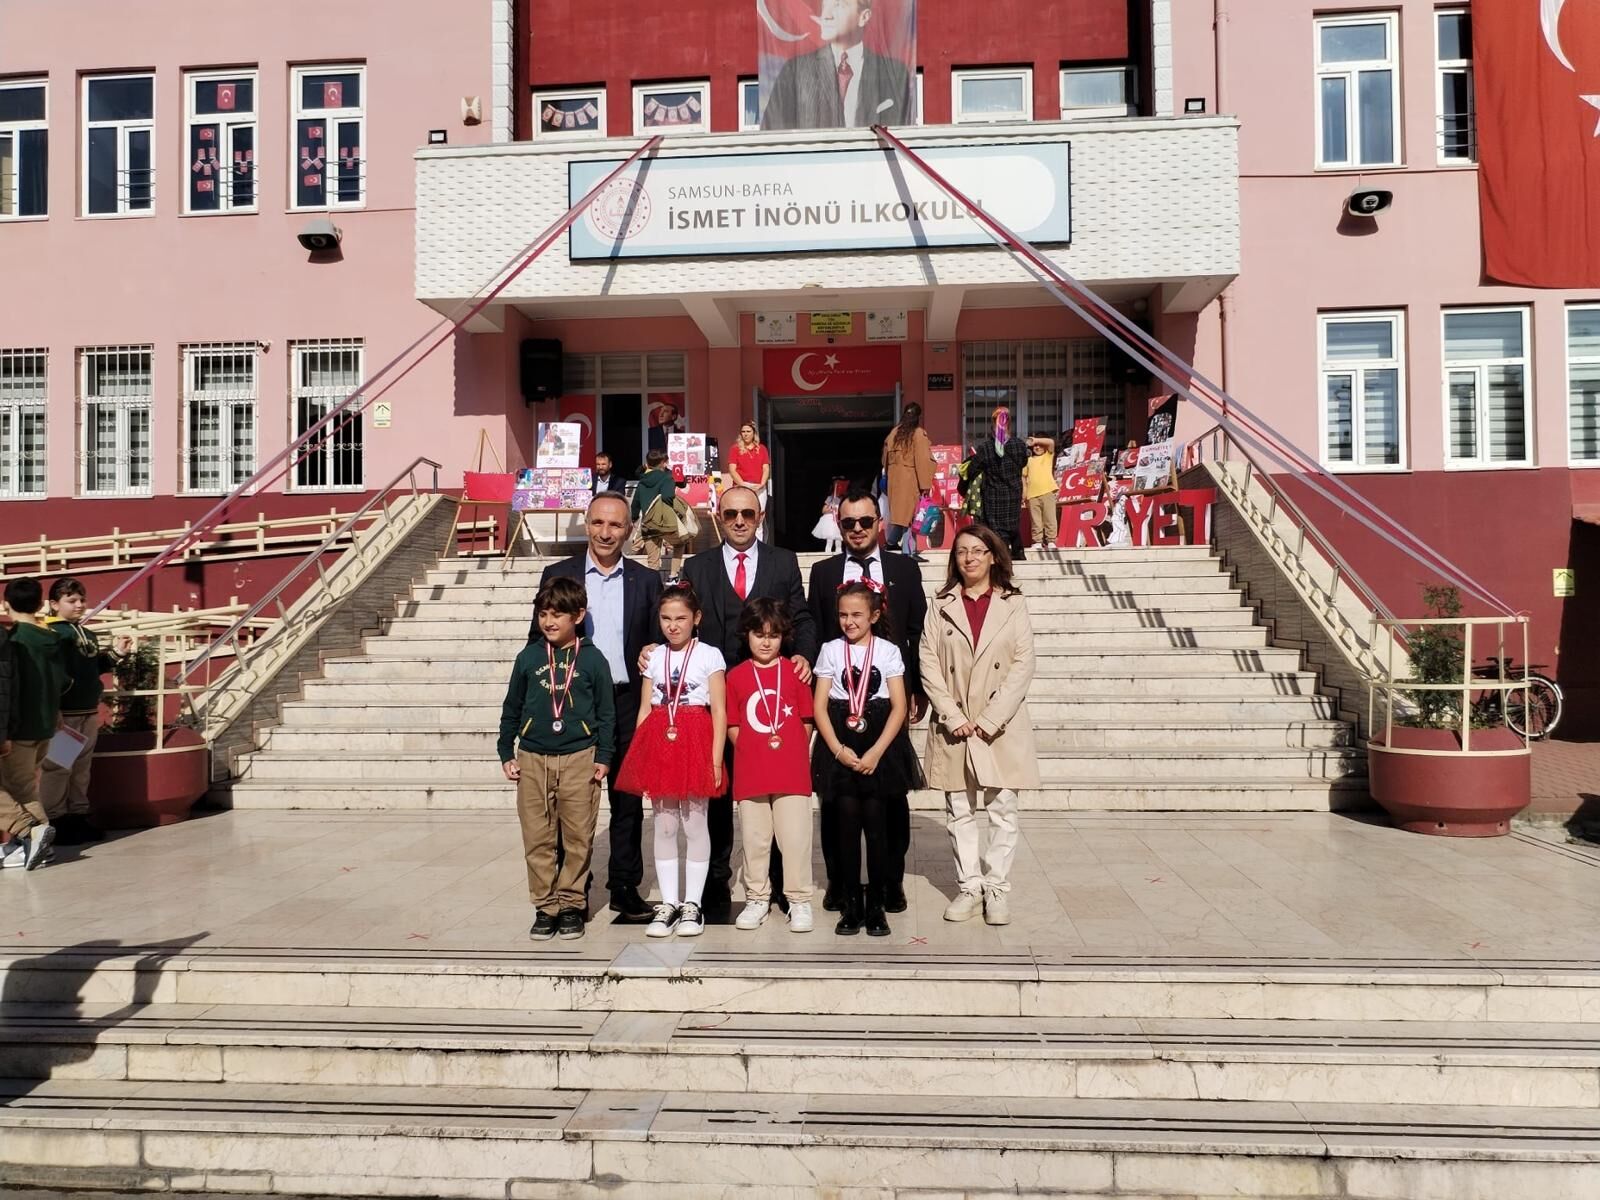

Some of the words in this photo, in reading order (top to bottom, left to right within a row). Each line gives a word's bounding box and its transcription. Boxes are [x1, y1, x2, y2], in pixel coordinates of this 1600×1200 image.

[668, 183, 793, 199] SAMSUN-BAFRA
[669, 206, 746, 230] İSMET
[755, 200, 841, 227] İNÖNÜ
